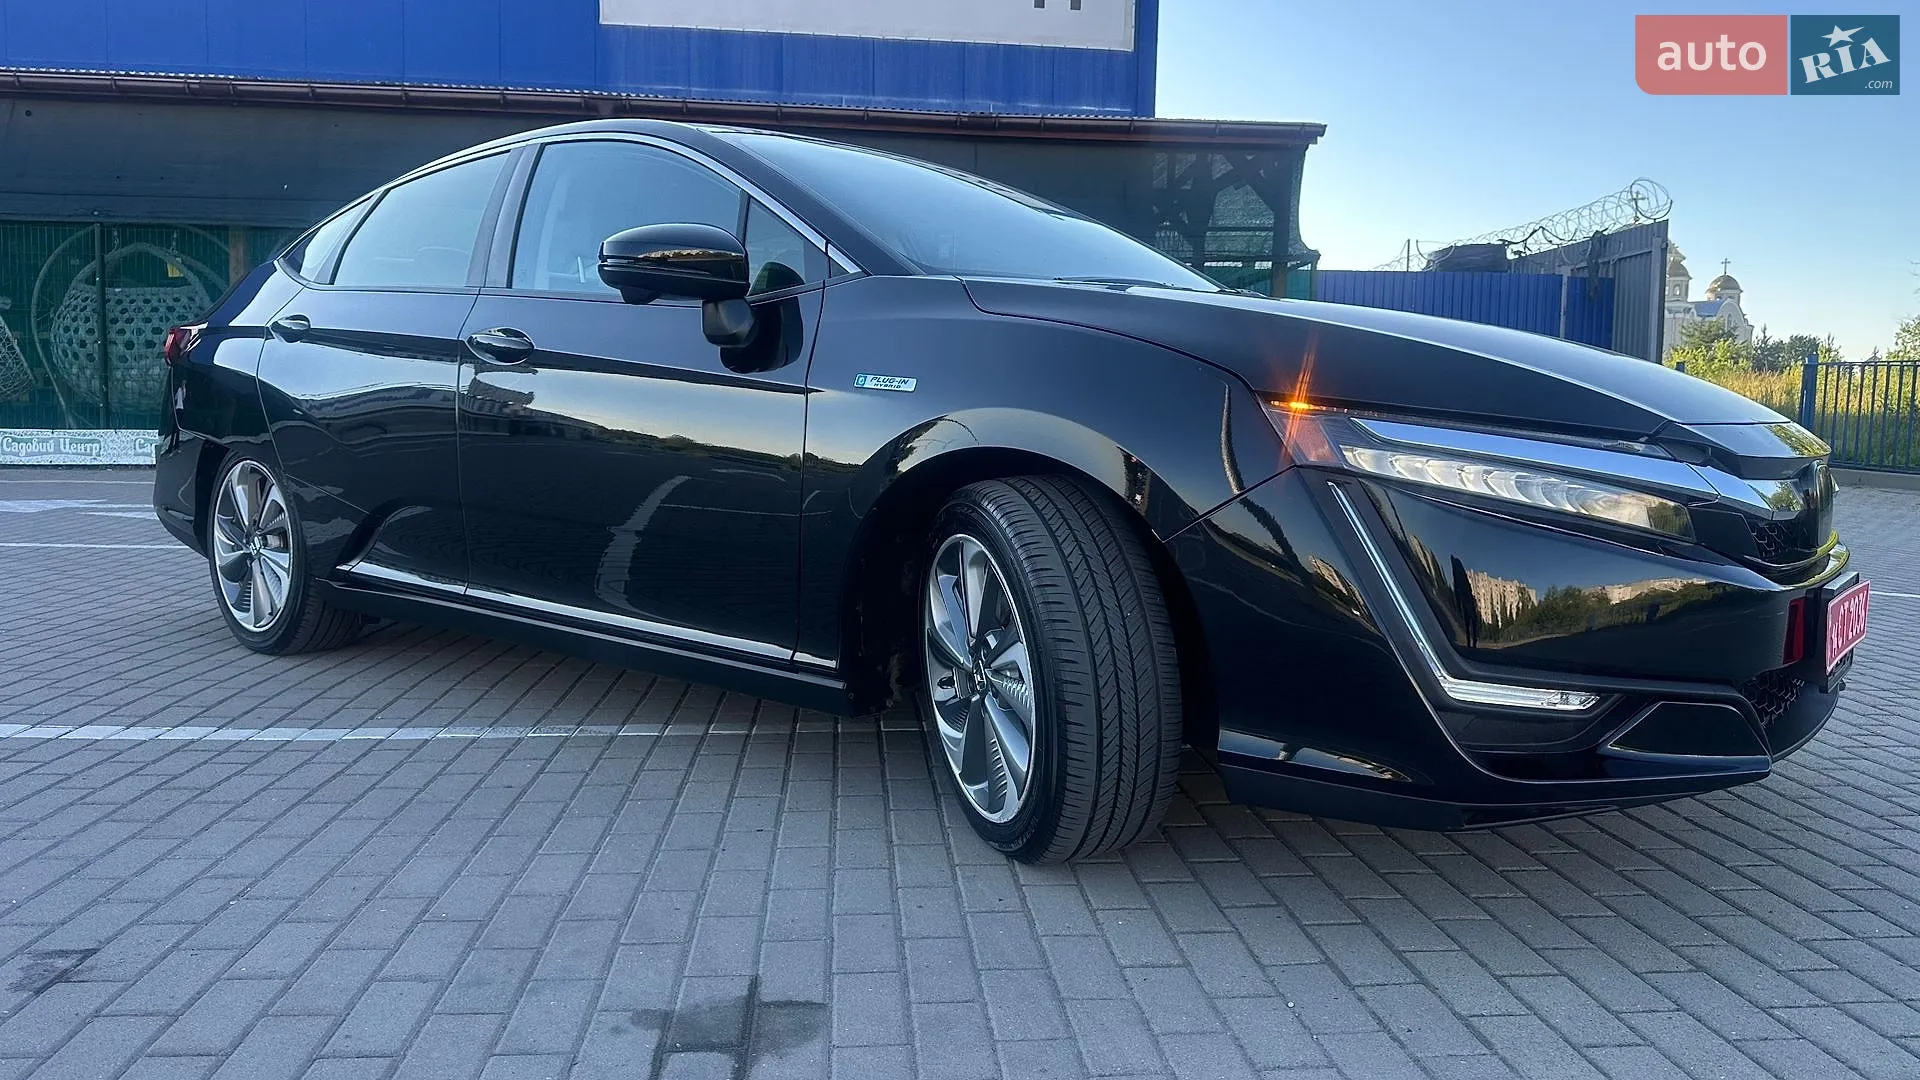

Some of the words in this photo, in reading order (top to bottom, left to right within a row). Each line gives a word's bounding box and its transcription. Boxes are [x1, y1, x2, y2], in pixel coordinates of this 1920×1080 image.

[870, 376, 910, 385] PLUG-IN
[2, 438, 55, 456] Садовий
[59, 438, 101, 457] Центр
